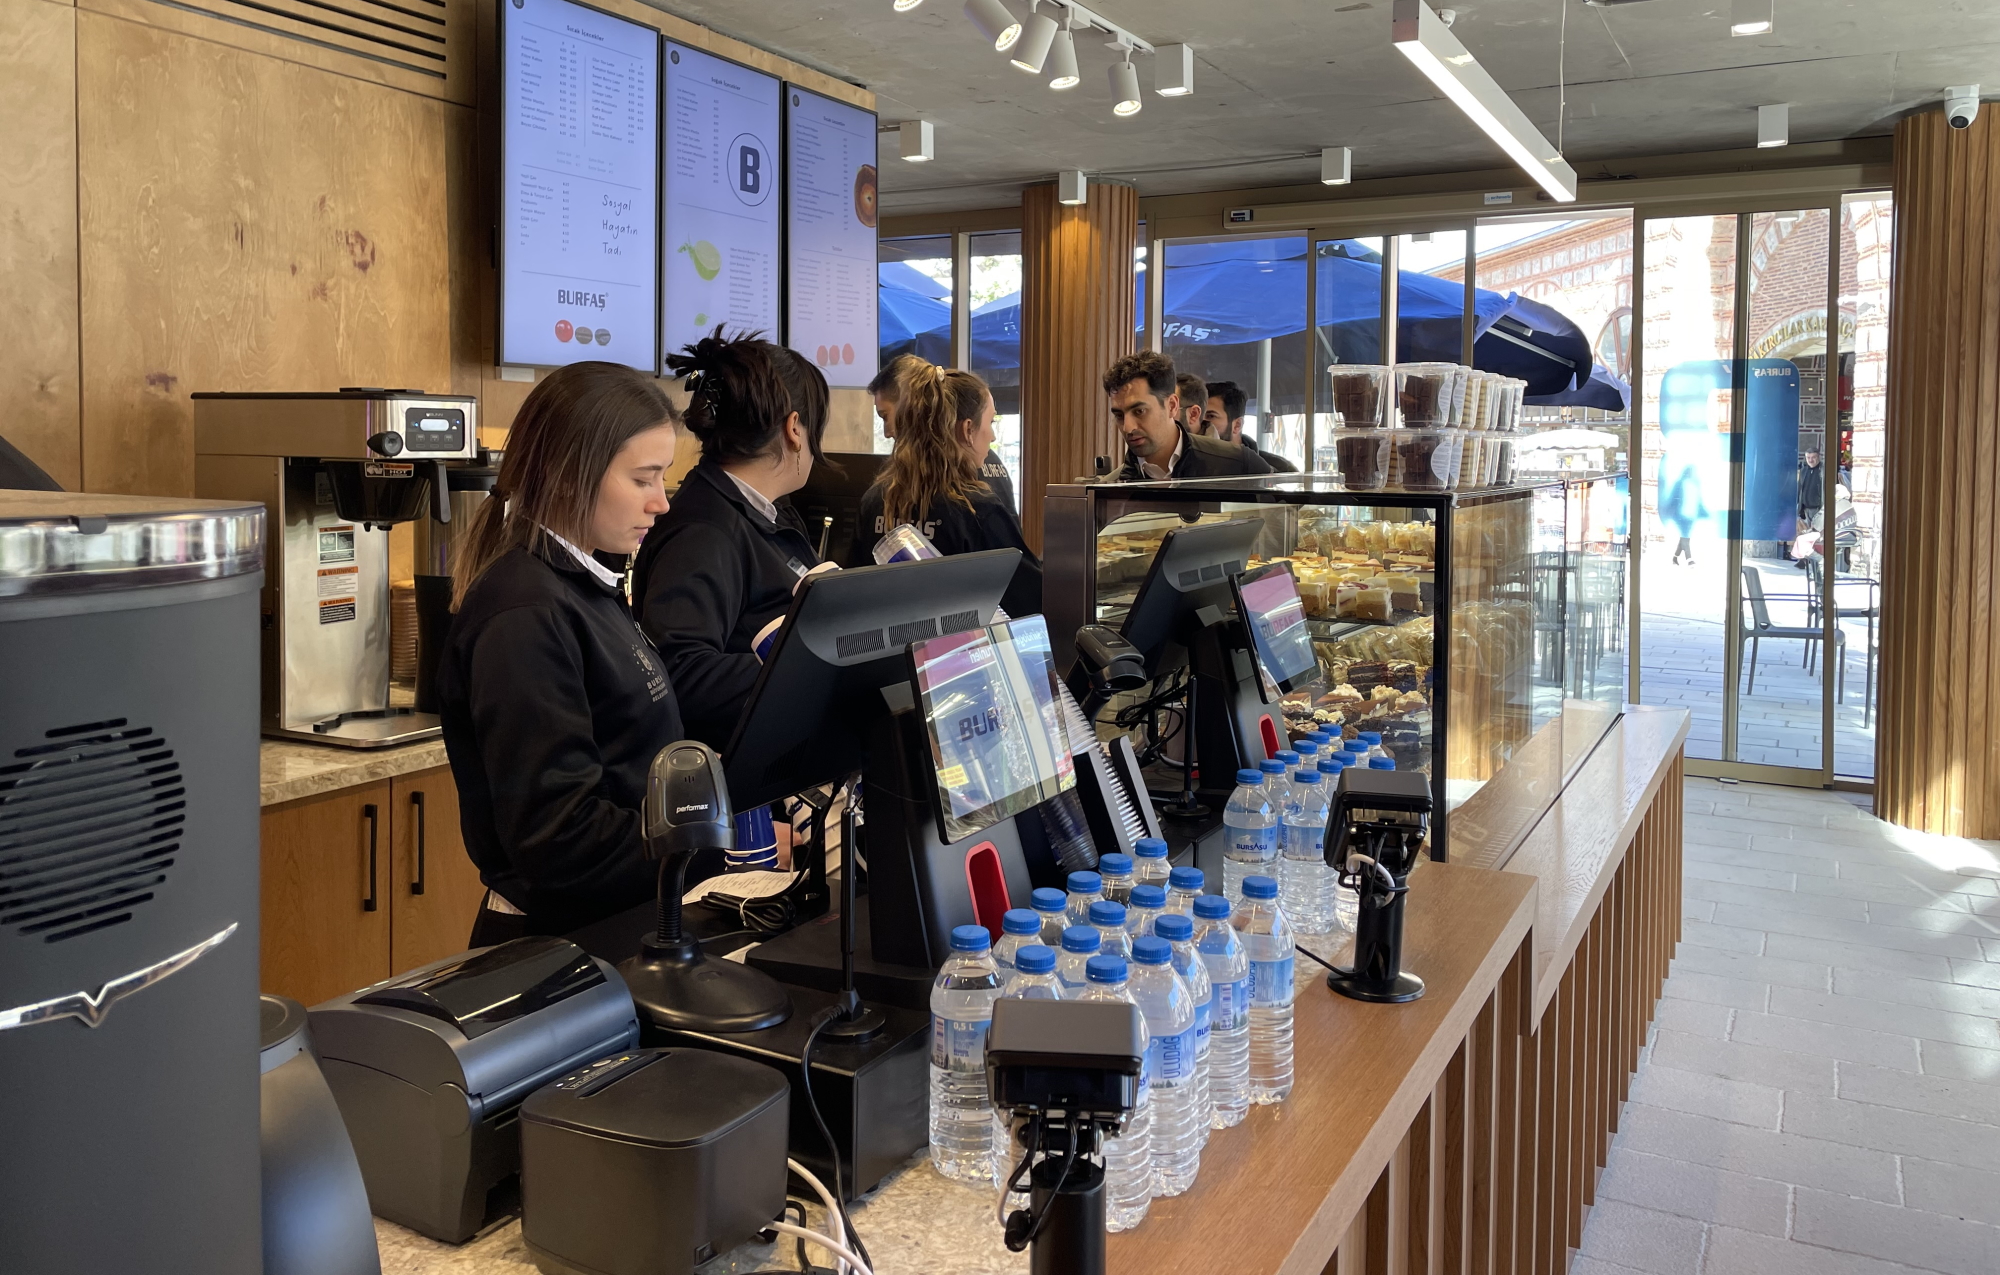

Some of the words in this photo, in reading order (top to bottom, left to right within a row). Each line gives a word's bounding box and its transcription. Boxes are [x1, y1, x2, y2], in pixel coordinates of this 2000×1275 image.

[566, 24, 580, 34] Sıcak
[602, 194, 632, 216] Sosyal
[602, 219, 638, 239] Hayatın
[602, 242, 622, 256] Tadı
[558, 289, 606, 312] BURFAŞ
[676, 804, 708, 814] performax
[953, 1022, 966, 1031] 0,5
